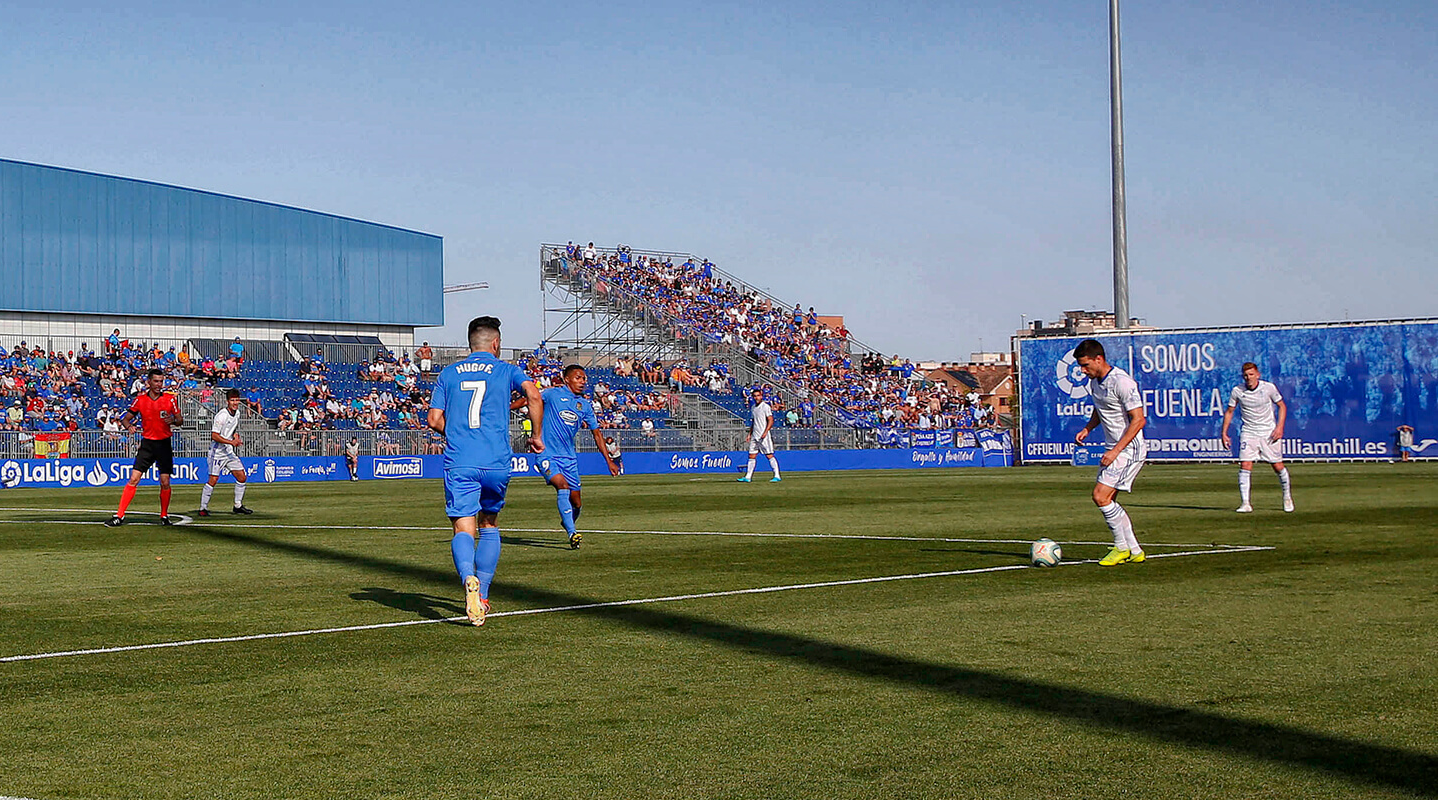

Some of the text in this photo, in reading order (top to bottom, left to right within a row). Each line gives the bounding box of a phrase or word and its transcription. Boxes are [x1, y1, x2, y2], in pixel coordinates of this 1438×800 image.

[1141, 343, 1215, 373] SOMOS
[460, 380, 487, 429] 7
[1056, 401, 1094, 419] LaLig
[1142, 388, 1224, 418] FUENLA
[1281, 438, 1387, 455] illiamhill.es
[375, 461, 420, 475] Avimosa
[670, 454, 731, 470] Somos Fuenla
[23, 460, 199, 487] LaLiga Smartank
